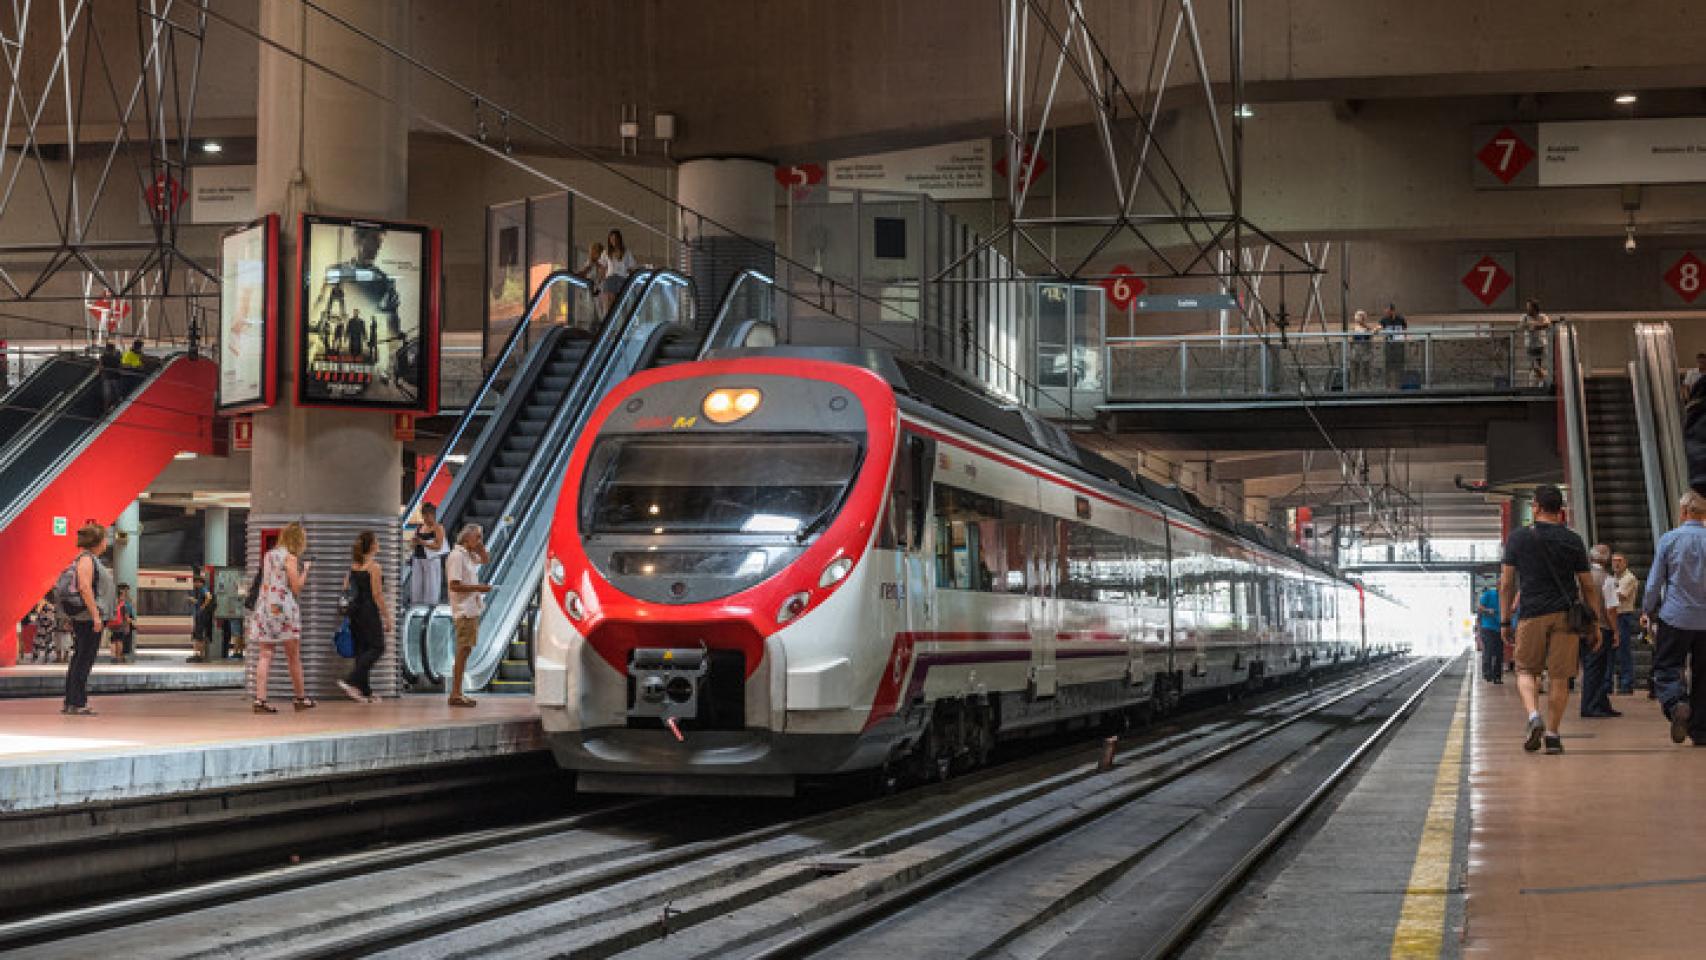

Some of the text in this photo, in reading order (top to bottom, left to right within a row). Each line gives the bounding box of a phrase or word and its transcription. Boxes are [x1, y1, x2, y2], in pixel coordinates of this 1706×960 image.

[1495, 138, 1516, 171] 7
[1113, 273, 1131, 300] 6
[1477, 265, 1497, 295] 7
[1679, 263, 1700, 291] 8
